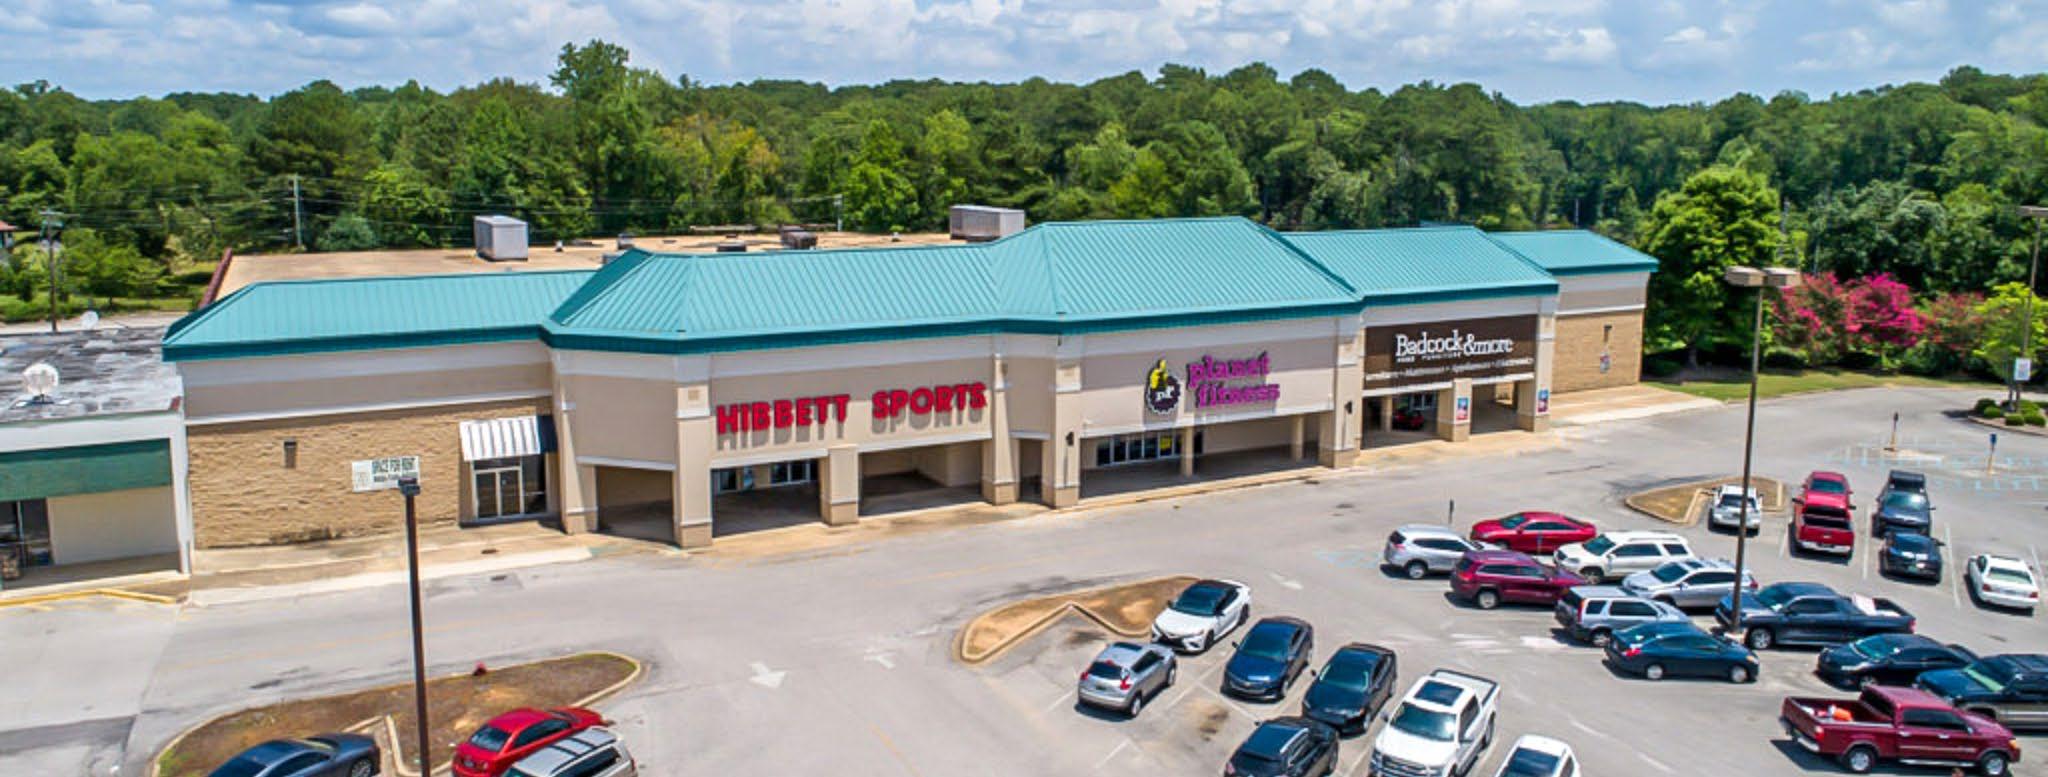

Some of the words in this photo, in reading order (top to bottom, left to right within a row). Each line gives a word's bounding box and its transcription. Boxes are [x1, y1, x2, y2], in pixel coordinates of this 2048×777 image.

[1395, 329, 1462, 357] Badcock
[1187, 350, 1271, 390] planet
[716, 393, 850, 435] HIBBETT
[872, 381, 988, 420] SPORTS
[1196, 382, 1281, 409] fitness
